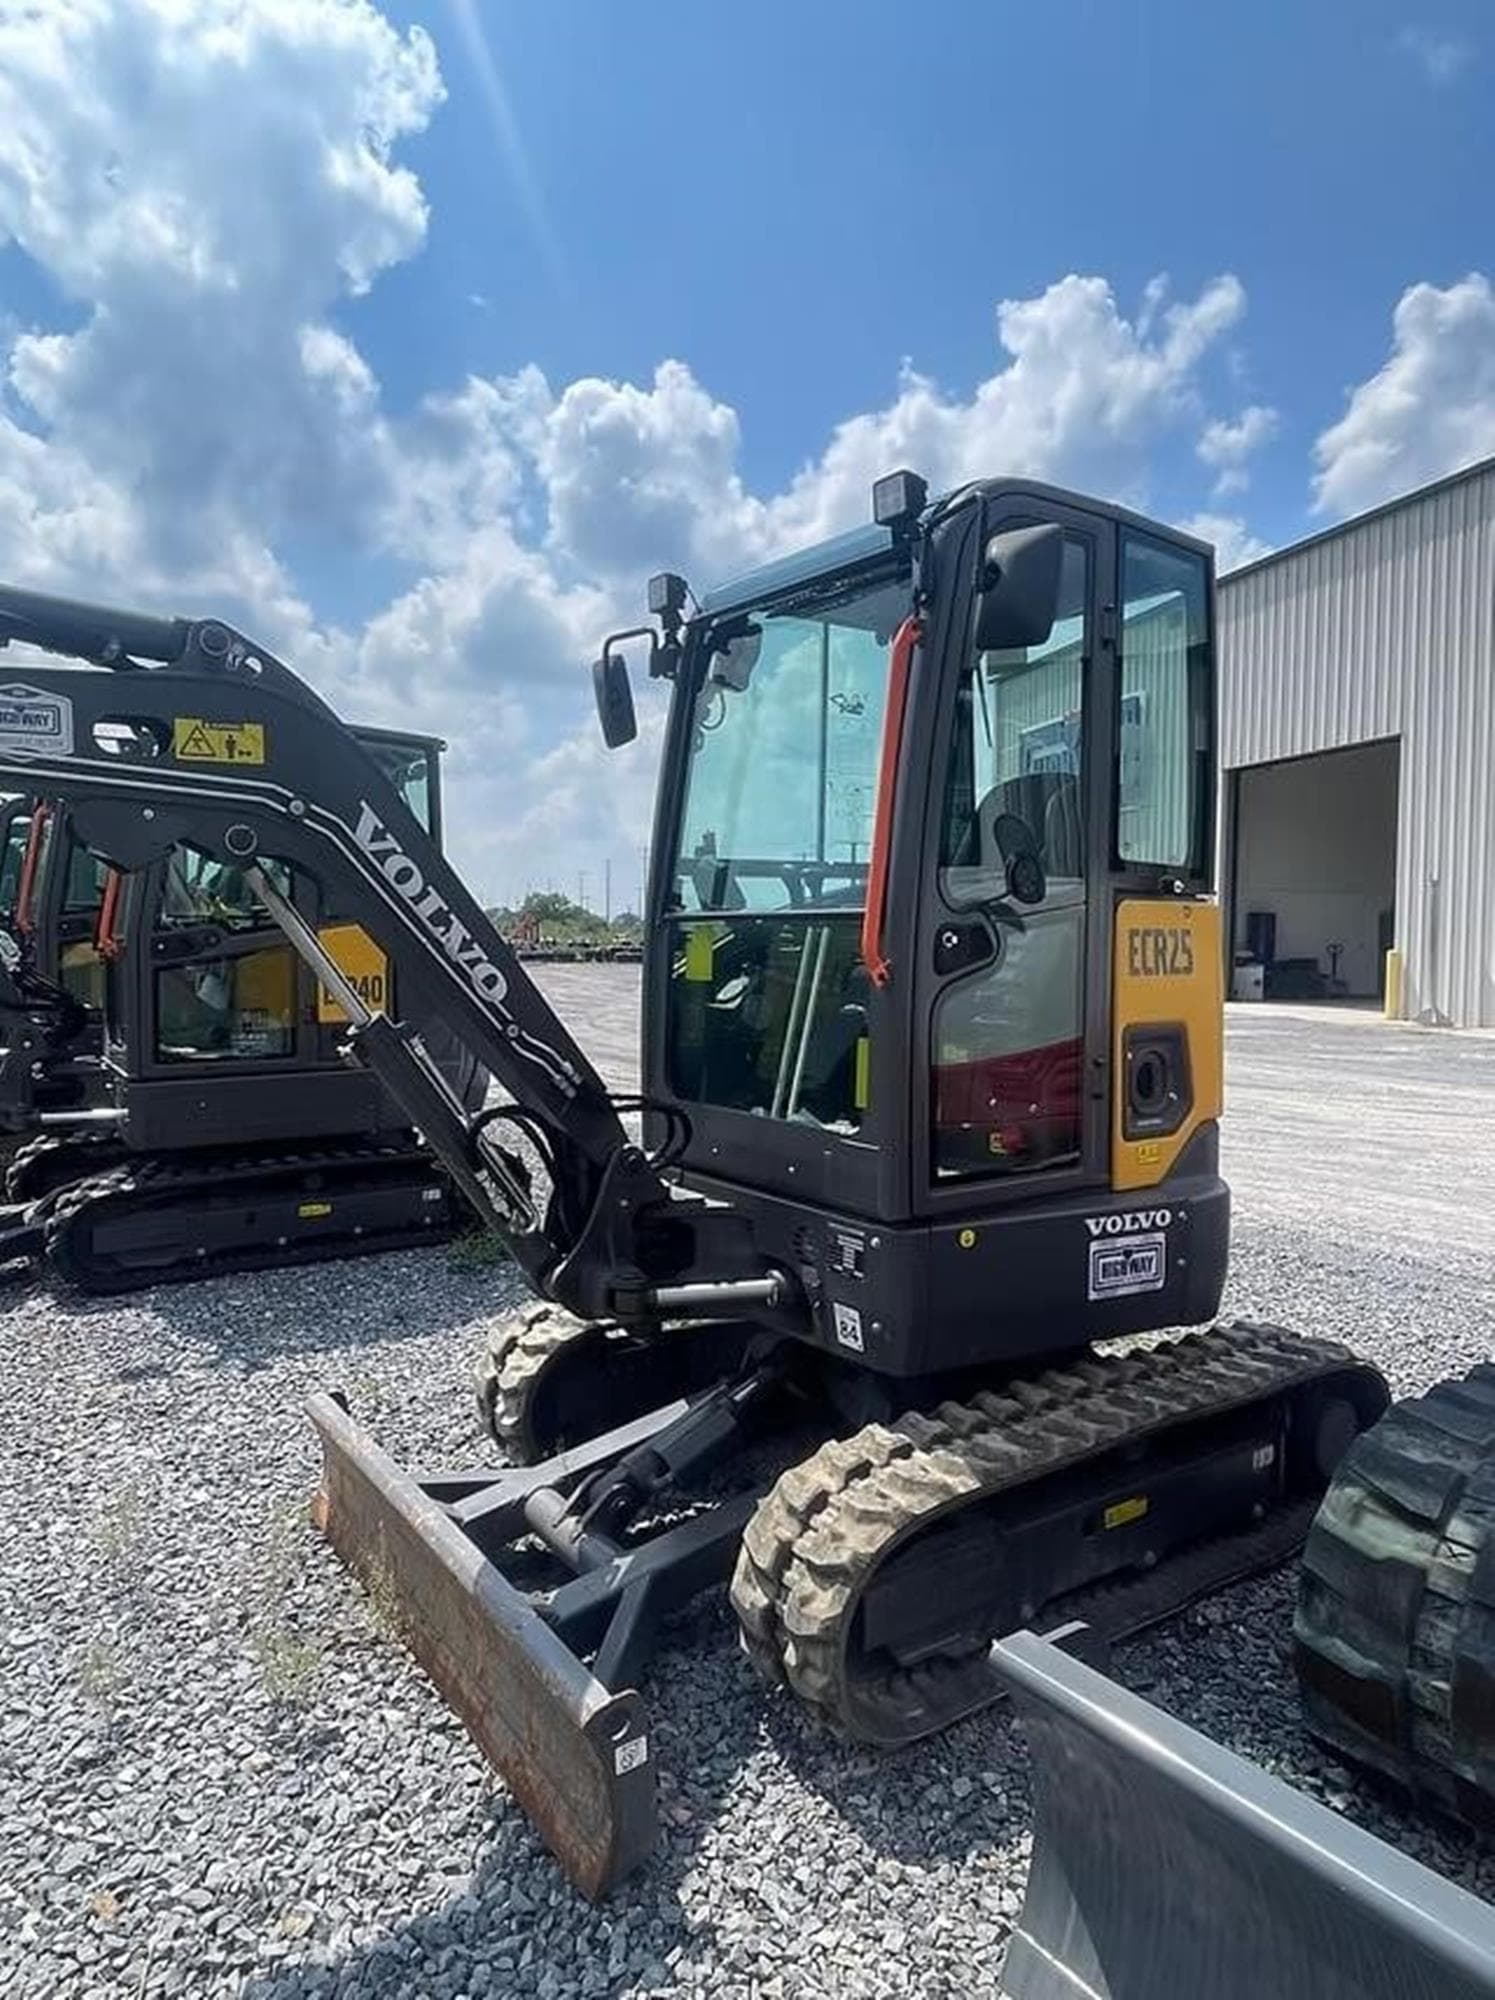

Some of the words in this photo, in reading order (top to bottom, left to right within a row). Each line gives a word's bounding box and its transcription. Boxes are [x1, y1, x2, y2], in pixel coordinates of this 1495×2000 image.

[356, 800, 508, 1002] VOLVO
[1129, 928, 1193, 976] ECR25
[1085, 1209, 1172, 1236] VOLVO
